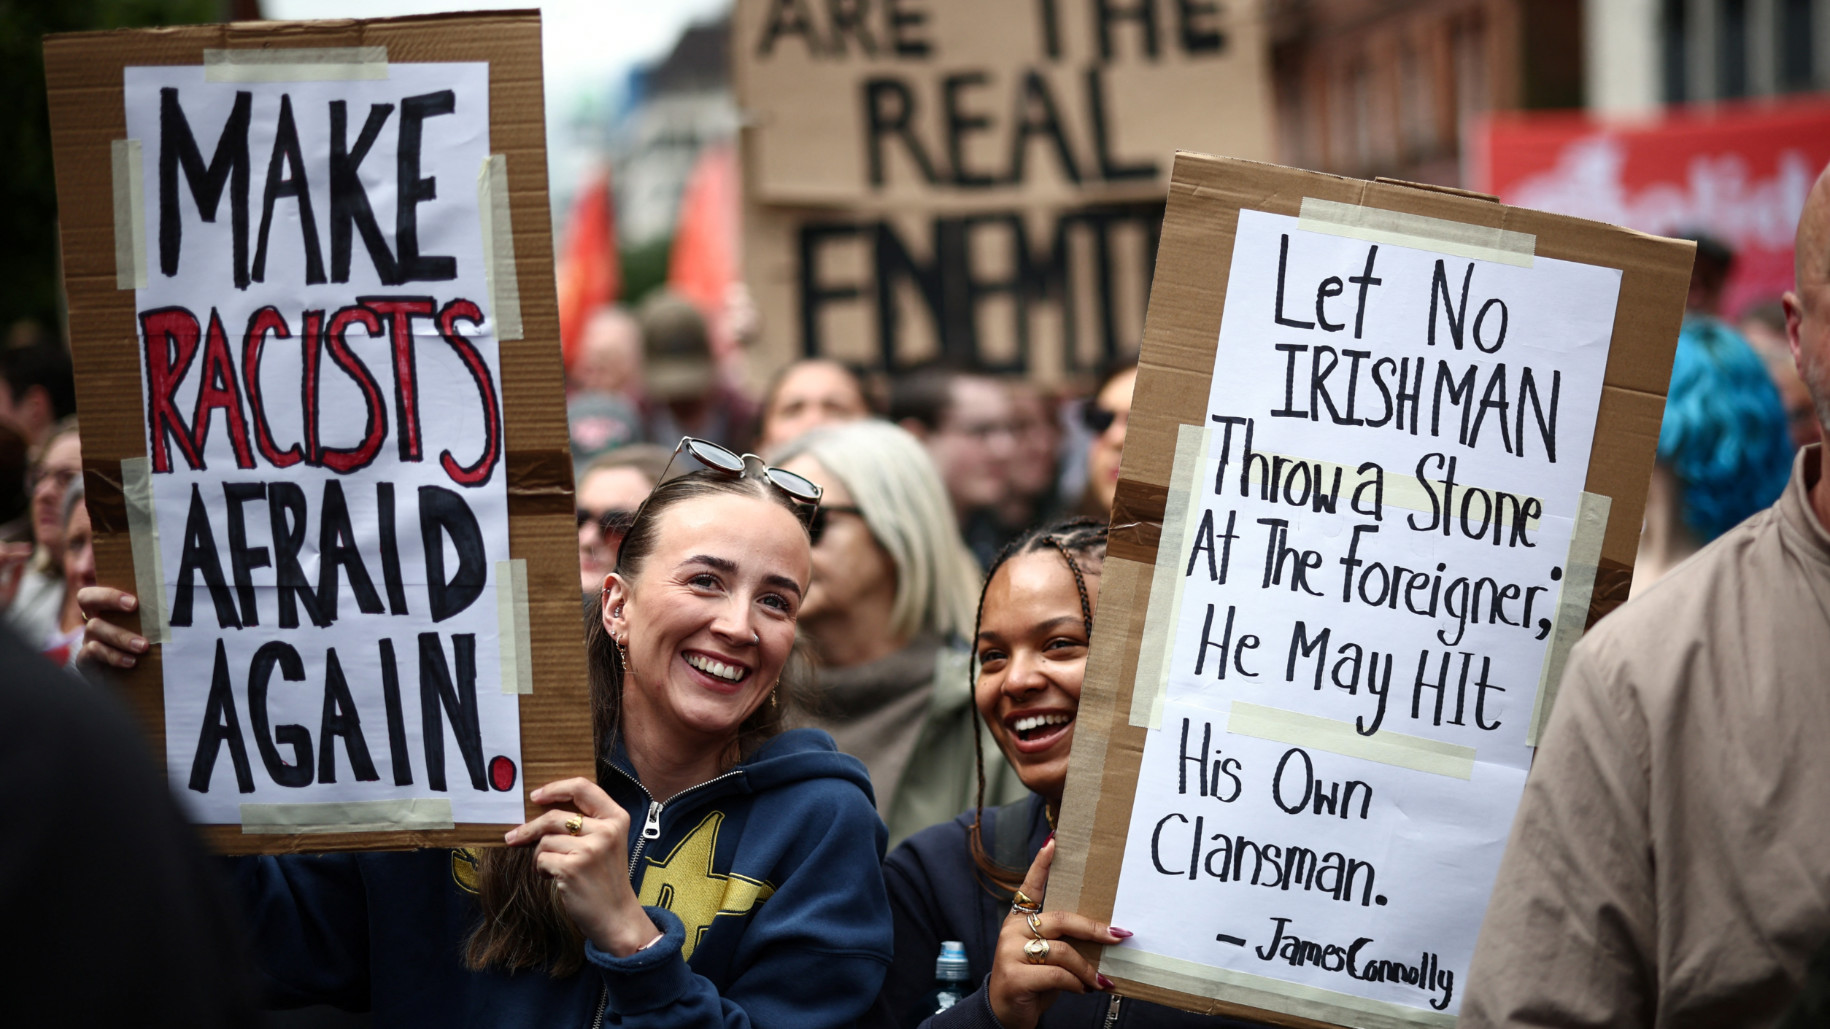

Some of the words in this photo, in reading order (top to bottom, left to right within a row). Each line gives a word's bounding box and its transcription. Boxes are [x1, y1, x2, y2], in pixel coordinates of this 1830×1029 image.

[160, 87, 457, 291] MAKE
[858, 68, 1158, 190] REAL
[798, 202, 1167, 370] ENEMI
[1274, 234, 1382, 339] Let
[1427, 259, 1508, 354] No
[138, 295, 500, 486] RACISTS
[1271, 343, 1560, 463] IRISHMAN
[169, 479, 486, 629] AFRAID
[1186, 509, 1239, 584] At
[1257, 518, 1324, 596] The
[1407, 453, 1542, 547] Stone
[188, 632, 517, 794] AGAIN.
[1194, 604, 1260, 679] He
[1286, 621, 1392, 736] May
[1179, 718, 1242, 802] His
[1273, 748, 1373, 819] Own
[1151, 813, 1388, 907] Clansman.
